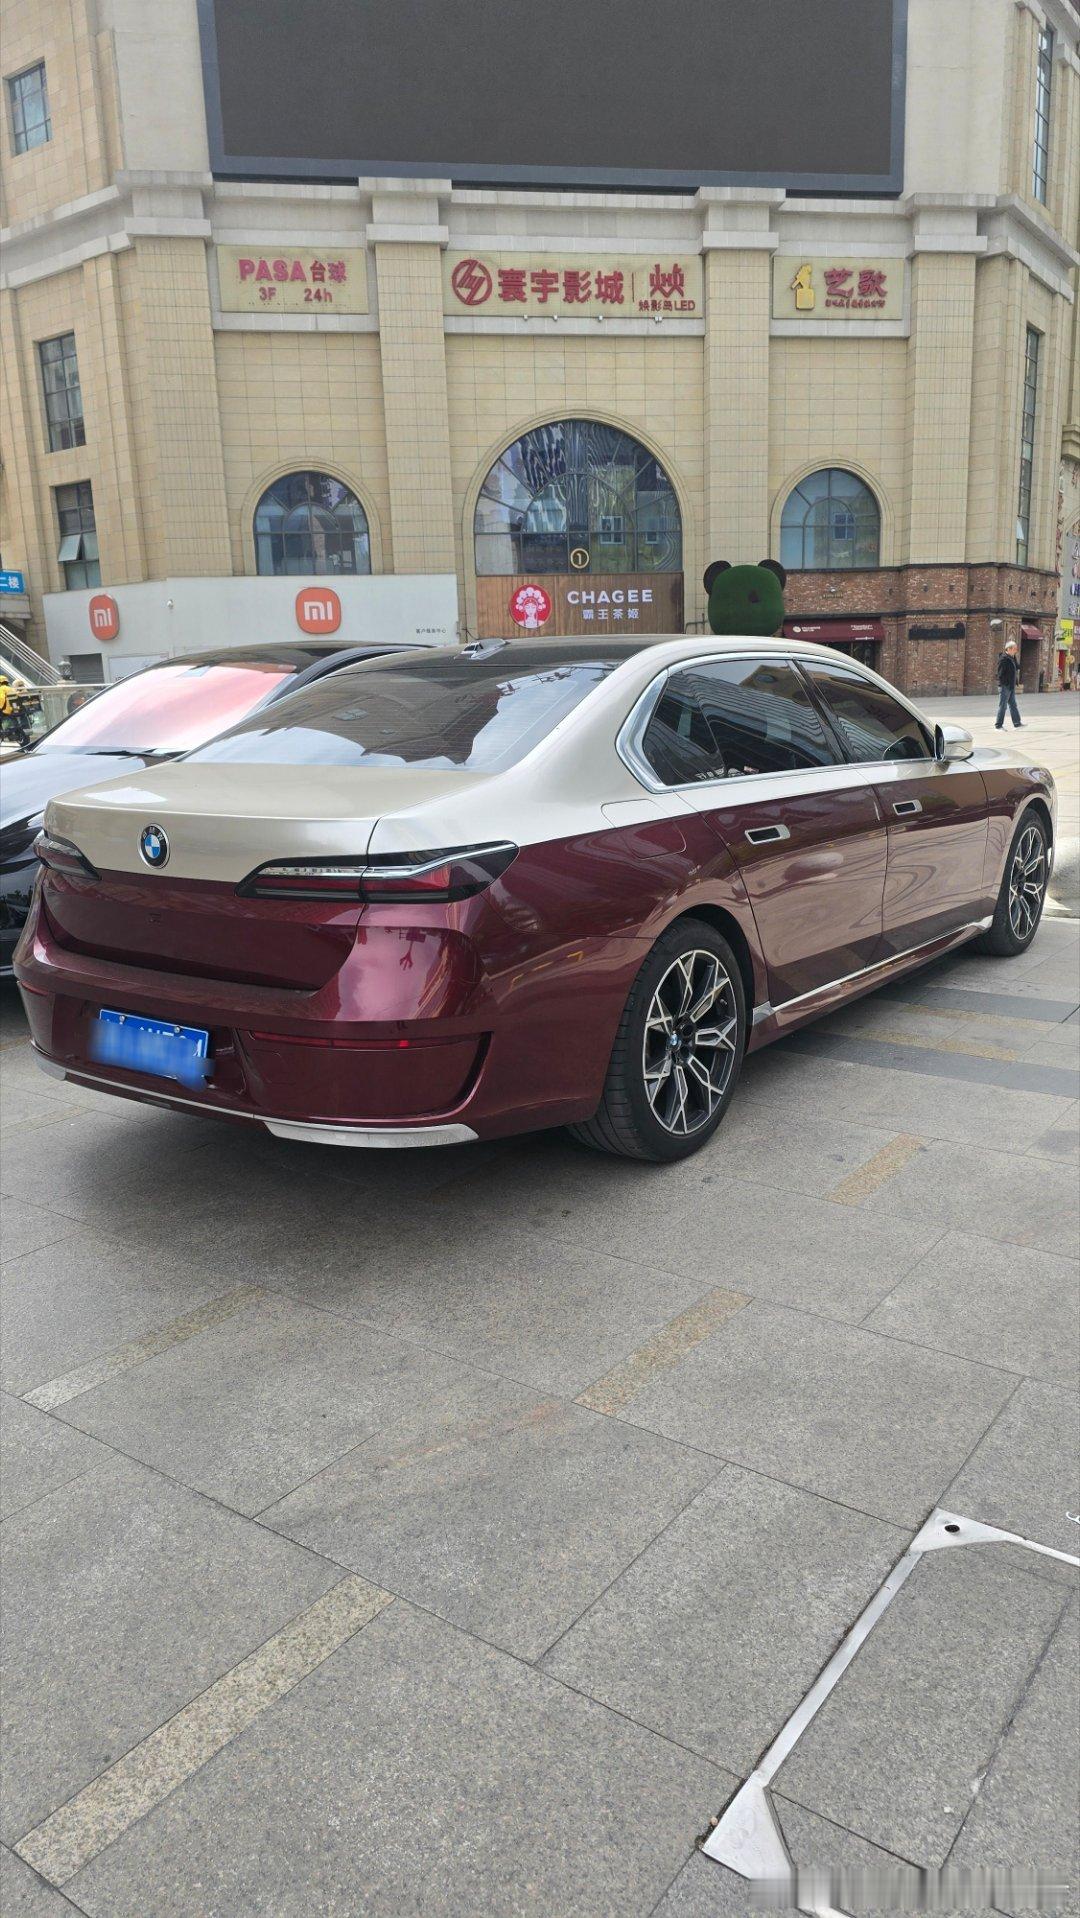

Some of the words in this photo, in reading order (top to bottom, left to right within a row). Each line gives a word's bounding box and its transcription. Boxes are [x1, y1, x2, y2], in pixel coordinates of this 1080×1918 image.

[238, 259, 306, 282] PASA
[310, 260, 347, 283] 台球
[259, 287, 277, 301] 3F
[304, 288, 332, 302] 24h
[498, 269, 624, 304] 寰宇影城
[567, 589, 653, 605] CHAGEE
[582, 608, 640, 621] 霸王茶姬
